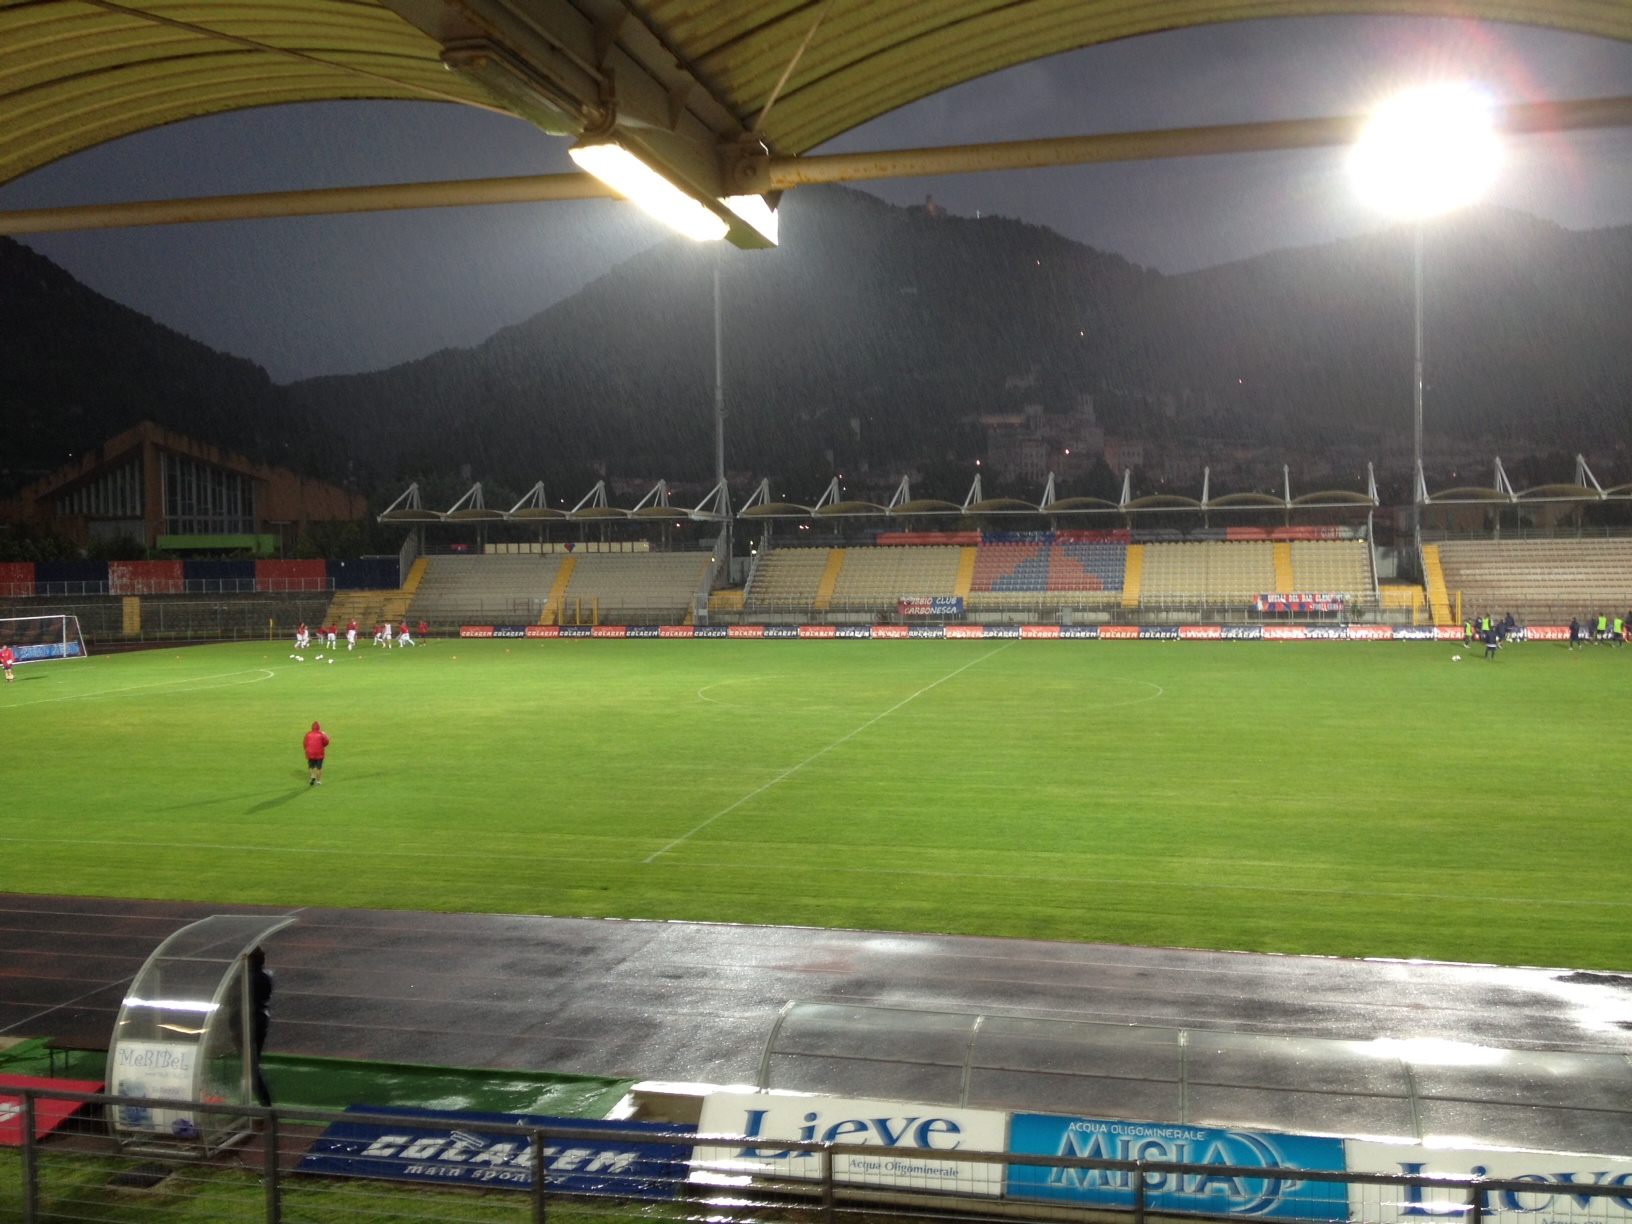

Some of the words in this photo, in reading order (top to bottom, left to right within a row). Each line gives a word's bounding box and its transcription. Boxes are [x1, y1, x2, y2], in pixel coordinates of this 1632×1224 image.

[119, 1048, 189, 1071] MeRIBeL
[735, 1109, 962, 1159] Lieve
[1068, 1122, 1107, 1134] ACQUA
[1111, 1124, 1204, 1140] OLIGOMINERALE
[360, 1135, 640, 1173] COLACEM
[1051, 1132, 1246, 1197] MISIA
[403, 1165, 461, 1177] main
[471, 1168, 569, 1184] sponor
[849, 1159, 881, 1172] Acqua
[884, 1161, 959, 1177] Oligominerale
